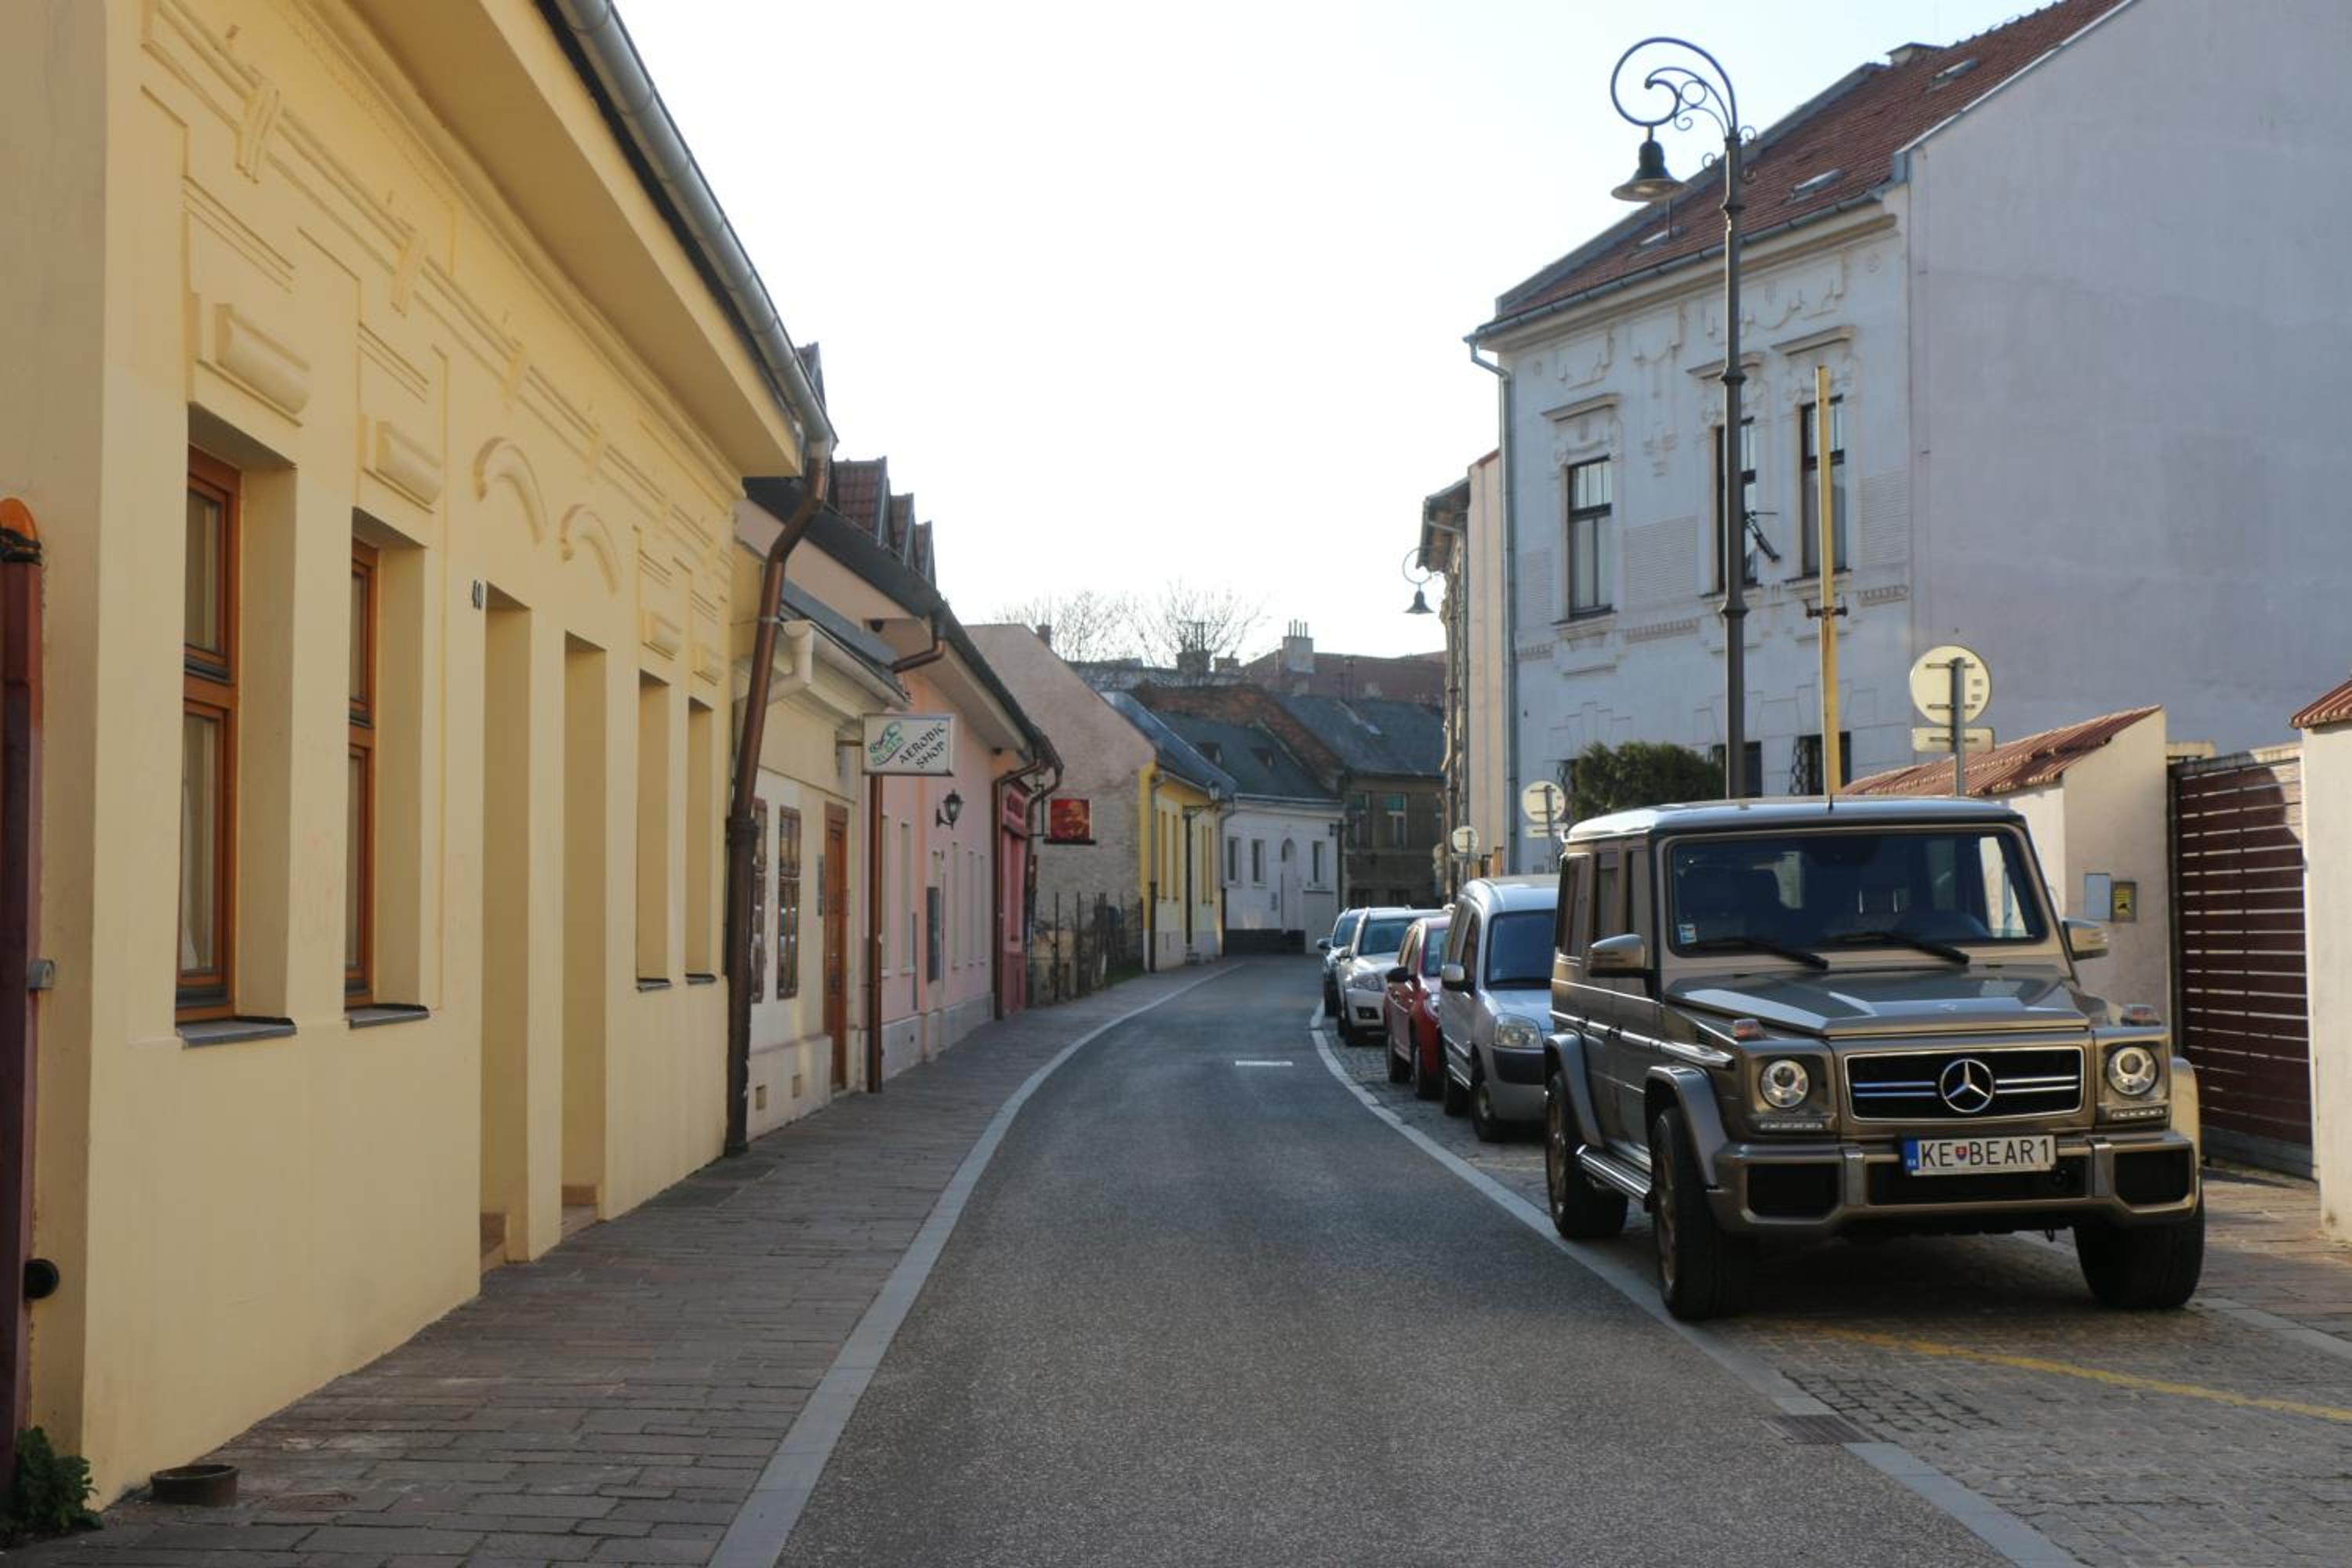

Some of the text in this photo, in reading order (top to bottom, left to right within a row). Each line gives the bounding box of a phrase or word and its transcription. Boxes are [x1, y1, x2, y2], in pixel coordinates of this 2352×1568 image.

[899, 723, 945, 764] AEROBIC
[915, 740, 945, 769] SHOP
[1922, 1138, 2049, 1167] KE BEAR1
